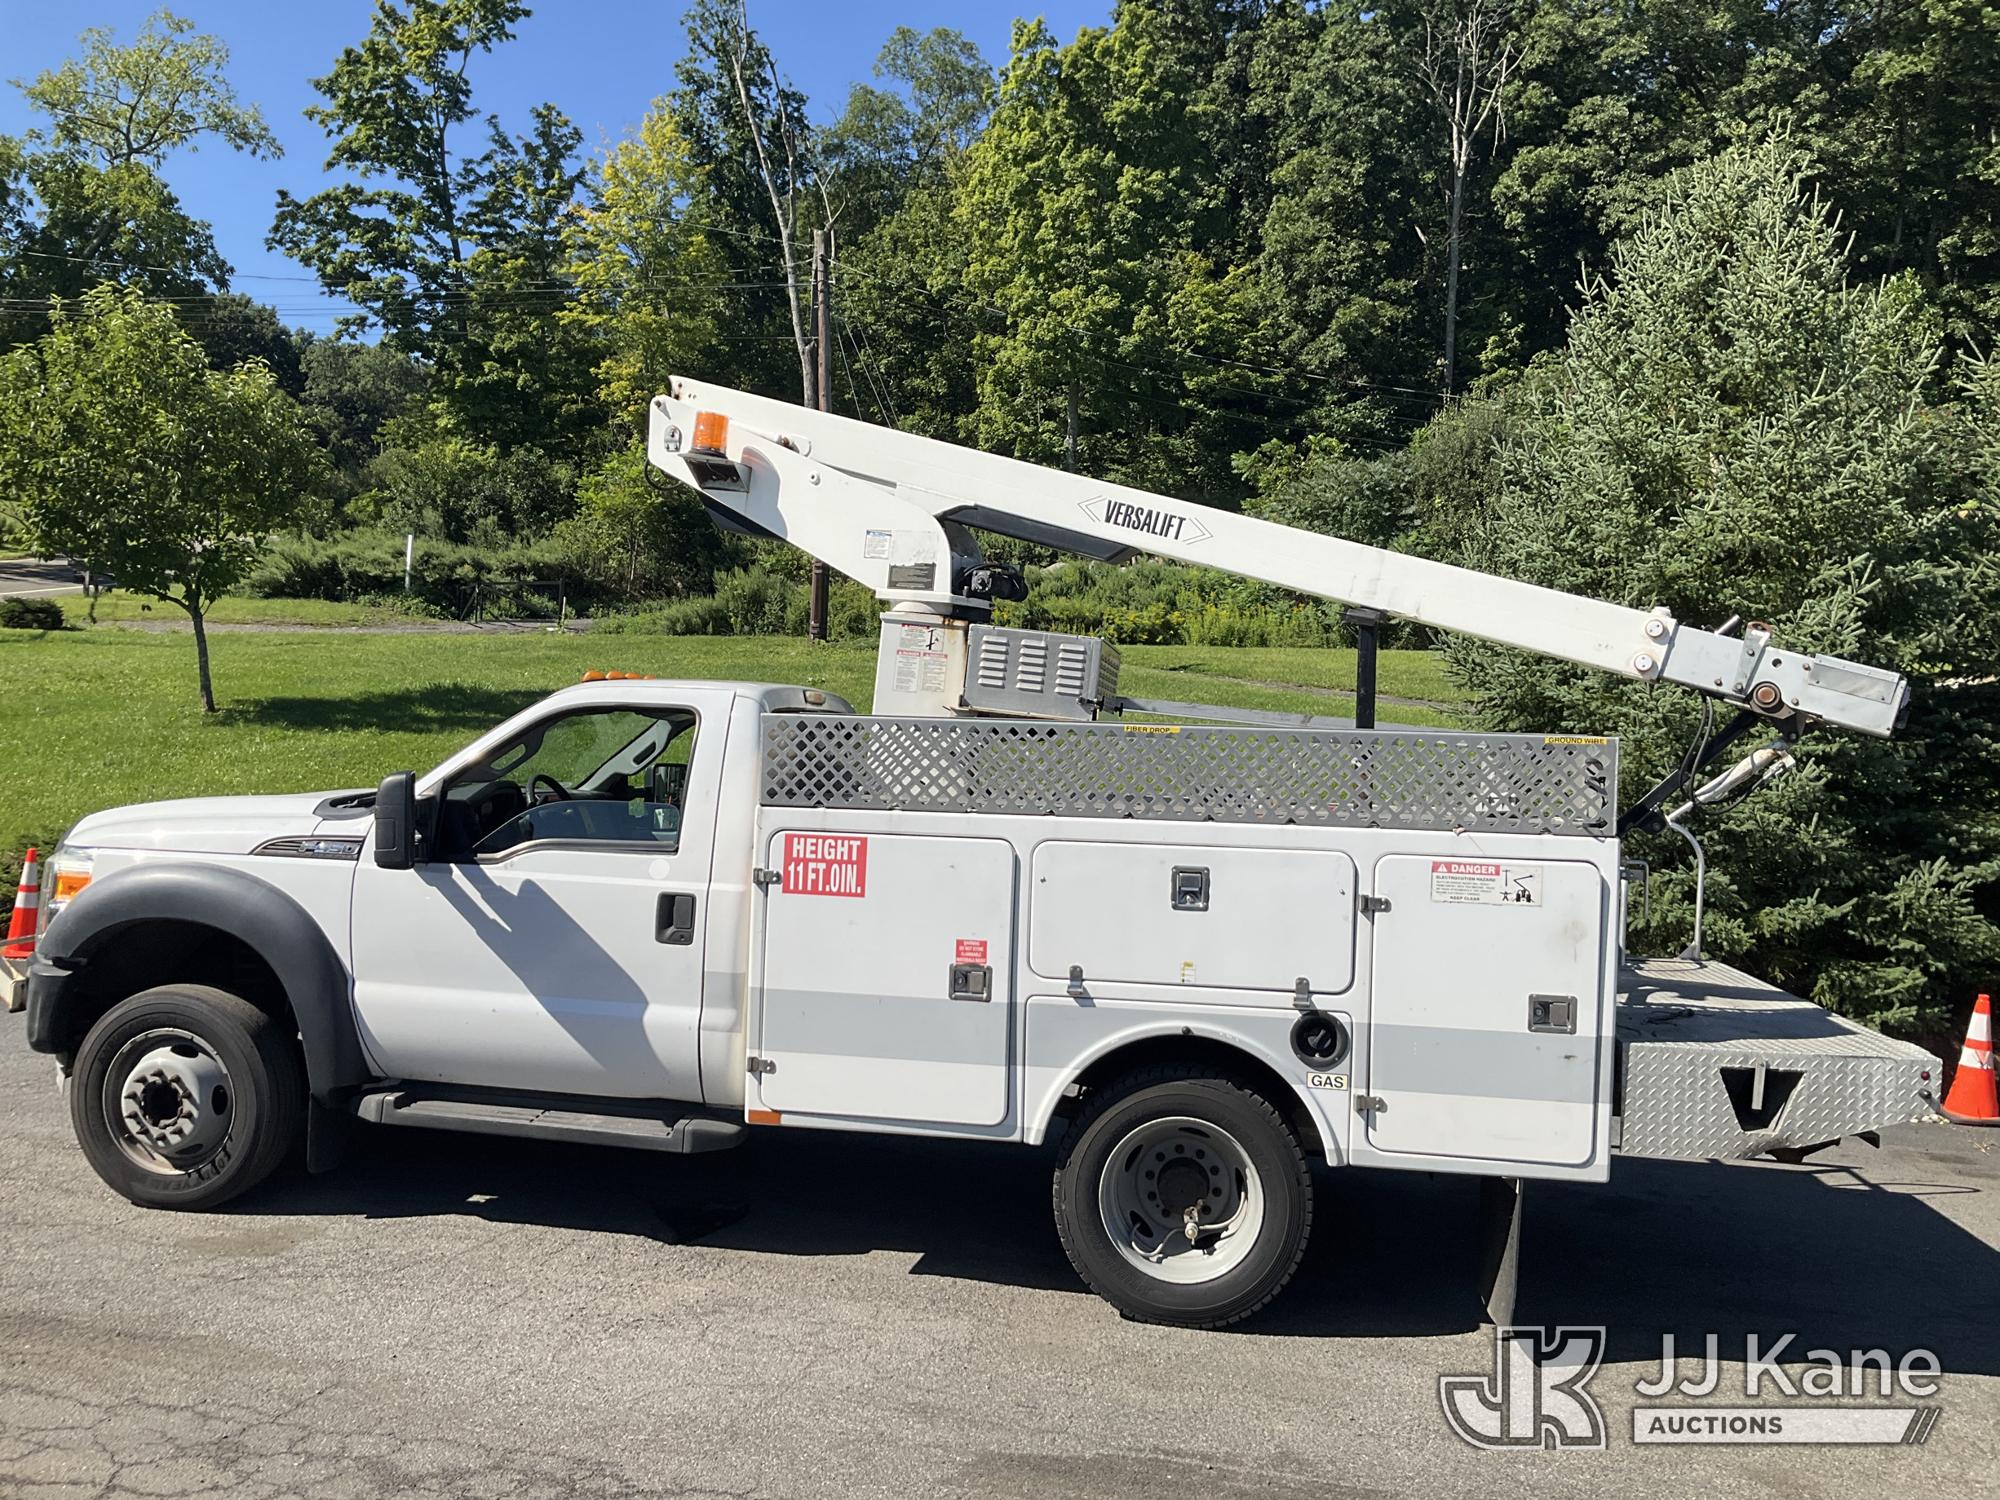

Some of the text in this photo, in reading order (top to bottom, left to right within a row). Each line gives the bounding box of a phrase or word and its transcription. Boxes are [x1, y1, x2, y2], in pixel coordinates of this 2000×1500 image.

[1104, 499, 1186, 540] VERSALIFT
[792, 837, 861, 861] HEIGHT
[1451, 864, 1496, 875] DANGER
[1311, 1074, 1344, 1089] GAS
